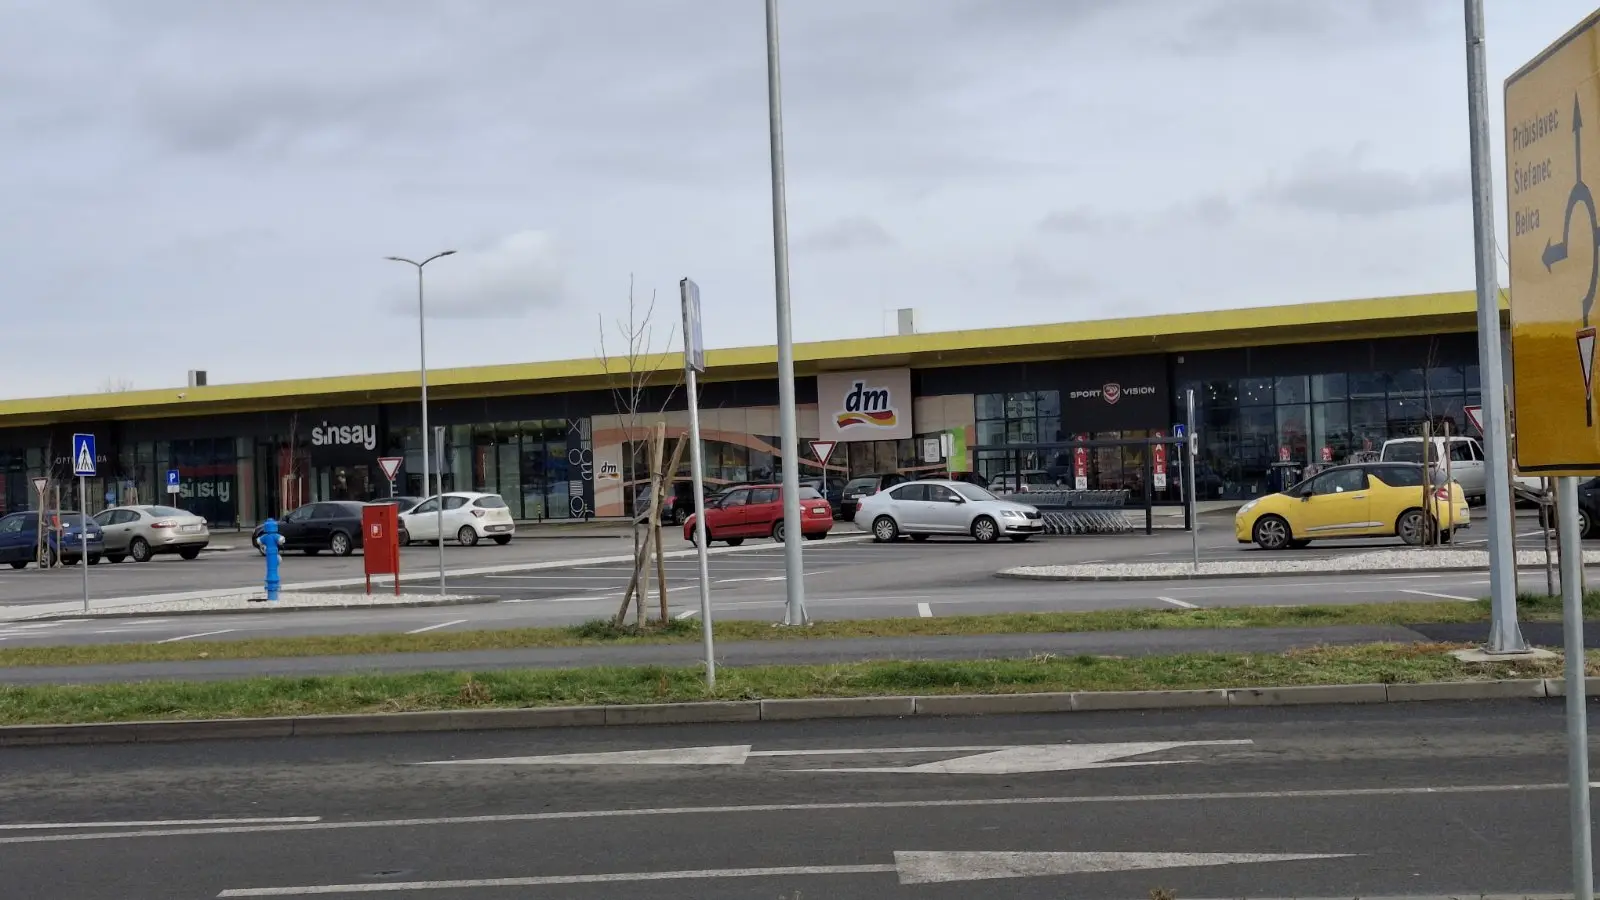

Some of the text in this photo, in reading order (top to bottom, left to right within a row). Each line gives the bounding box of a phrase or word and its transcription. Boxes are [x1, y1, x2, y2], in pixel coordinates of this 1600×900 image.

[1512, 108, 1559, 152] Pribislavec
[1514, 157, 1551, 195] Štefanec
[1515, 208, 1540, 236] Belica
[845, 382, 888, 412] dm
[1070, 386, 1155, 399] SPORT VISION
[312, 421, 376, 450] sinsay
[170, 473, 176, 483] P
[600, 461, 617, 473] dm
